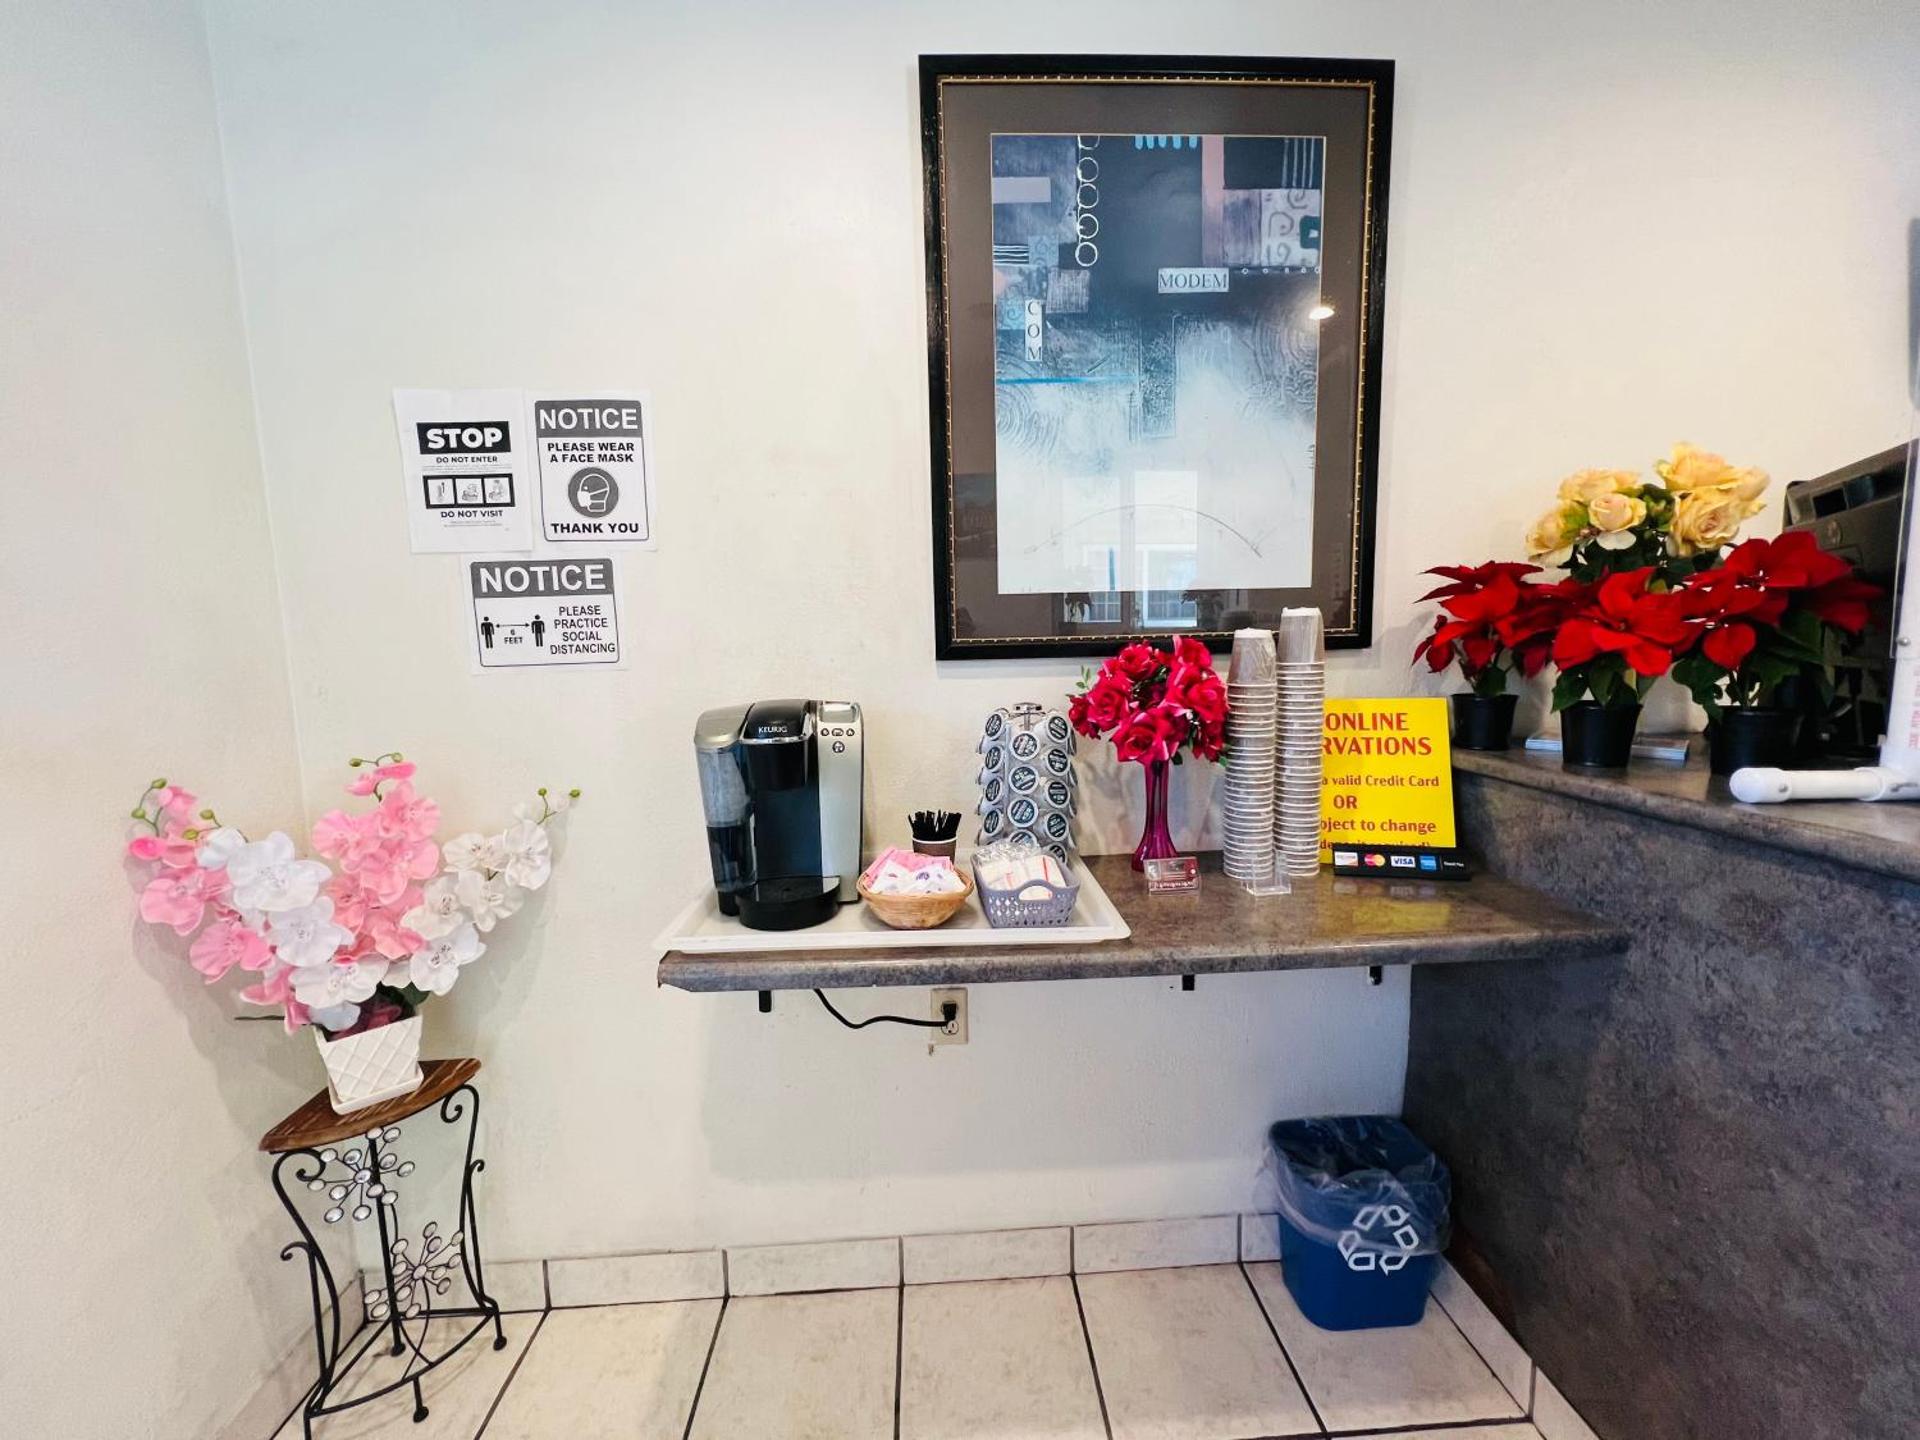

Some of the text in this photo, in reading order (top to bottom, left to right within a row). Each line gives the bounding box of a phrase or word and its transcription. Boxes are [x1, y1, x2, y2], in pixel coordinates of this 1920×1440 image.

[1159, 272, 1227, 289] MODEM
[539, 407, 639, 430] NOTICE
[426, 427, 503, 449] STOP
[547, 442, 635, 452] PLEASE WEAR
[436, 455, 498, 464] DO NOT ENTER
[550, 453, 634, 463] A FACE MASK
[457, 510, 478, 518] NOT
[480, 509, 503, 518] VISIT
[551, 523, 639, 534] THANK YOU
[479, 564, 606, 593] NOTICE
[558, 605, 601, 617] PLEASE
[554, 618, 608, 629] PRACTICE
[504, 637, 523, 645] FEET
[562, 631, 602, 642] SOCIAL
[550, 643, 616, 655] DISTANCING
[1325, 712, 1409, 731] ONLINE
[758, 726, 788, 734] KEURIG
[1332, 775, 1362, 786] valid
[1365, 775, 1405, 787] Credit
[1408, 776, 1440, 787] Card
[1333, 795, 1358, 810] OR
[1360, 819, 1376, 832] to
[1380, 820, 1436, 835] change
[1393, 857, 1414, 866] VISA
